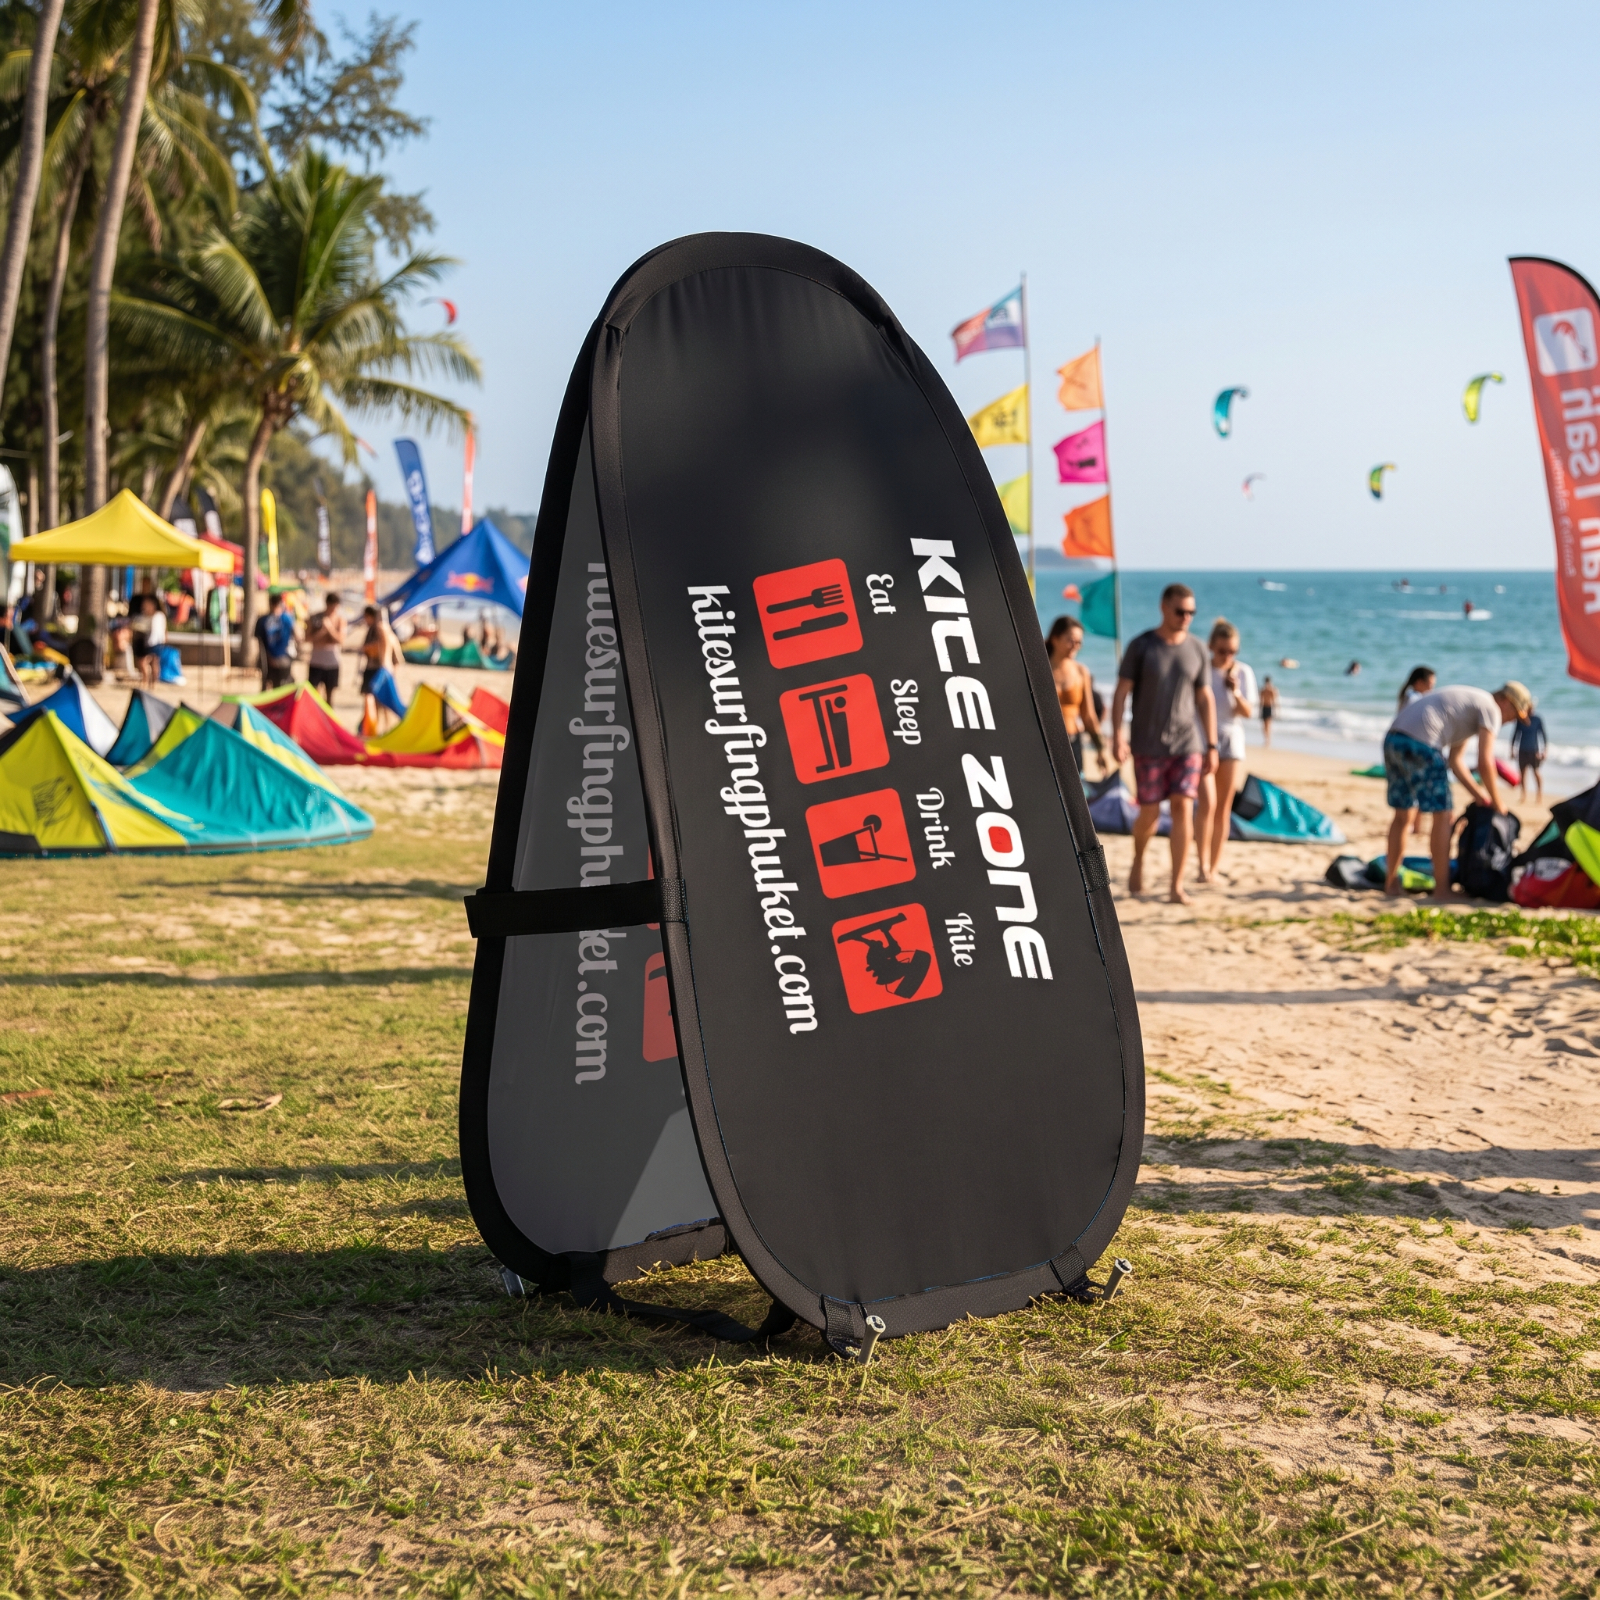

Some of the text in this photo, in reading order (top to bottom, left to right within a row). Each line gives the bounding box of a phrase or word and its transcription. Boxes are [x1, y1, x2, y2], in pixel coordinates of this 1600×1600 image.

[687, 585, 818, 1035] kitesurfingphuket.com
[865, 573, 975, 967] Eat Sleep Drink Kite
[910, 537, 1054, 980] KITE ZONE
